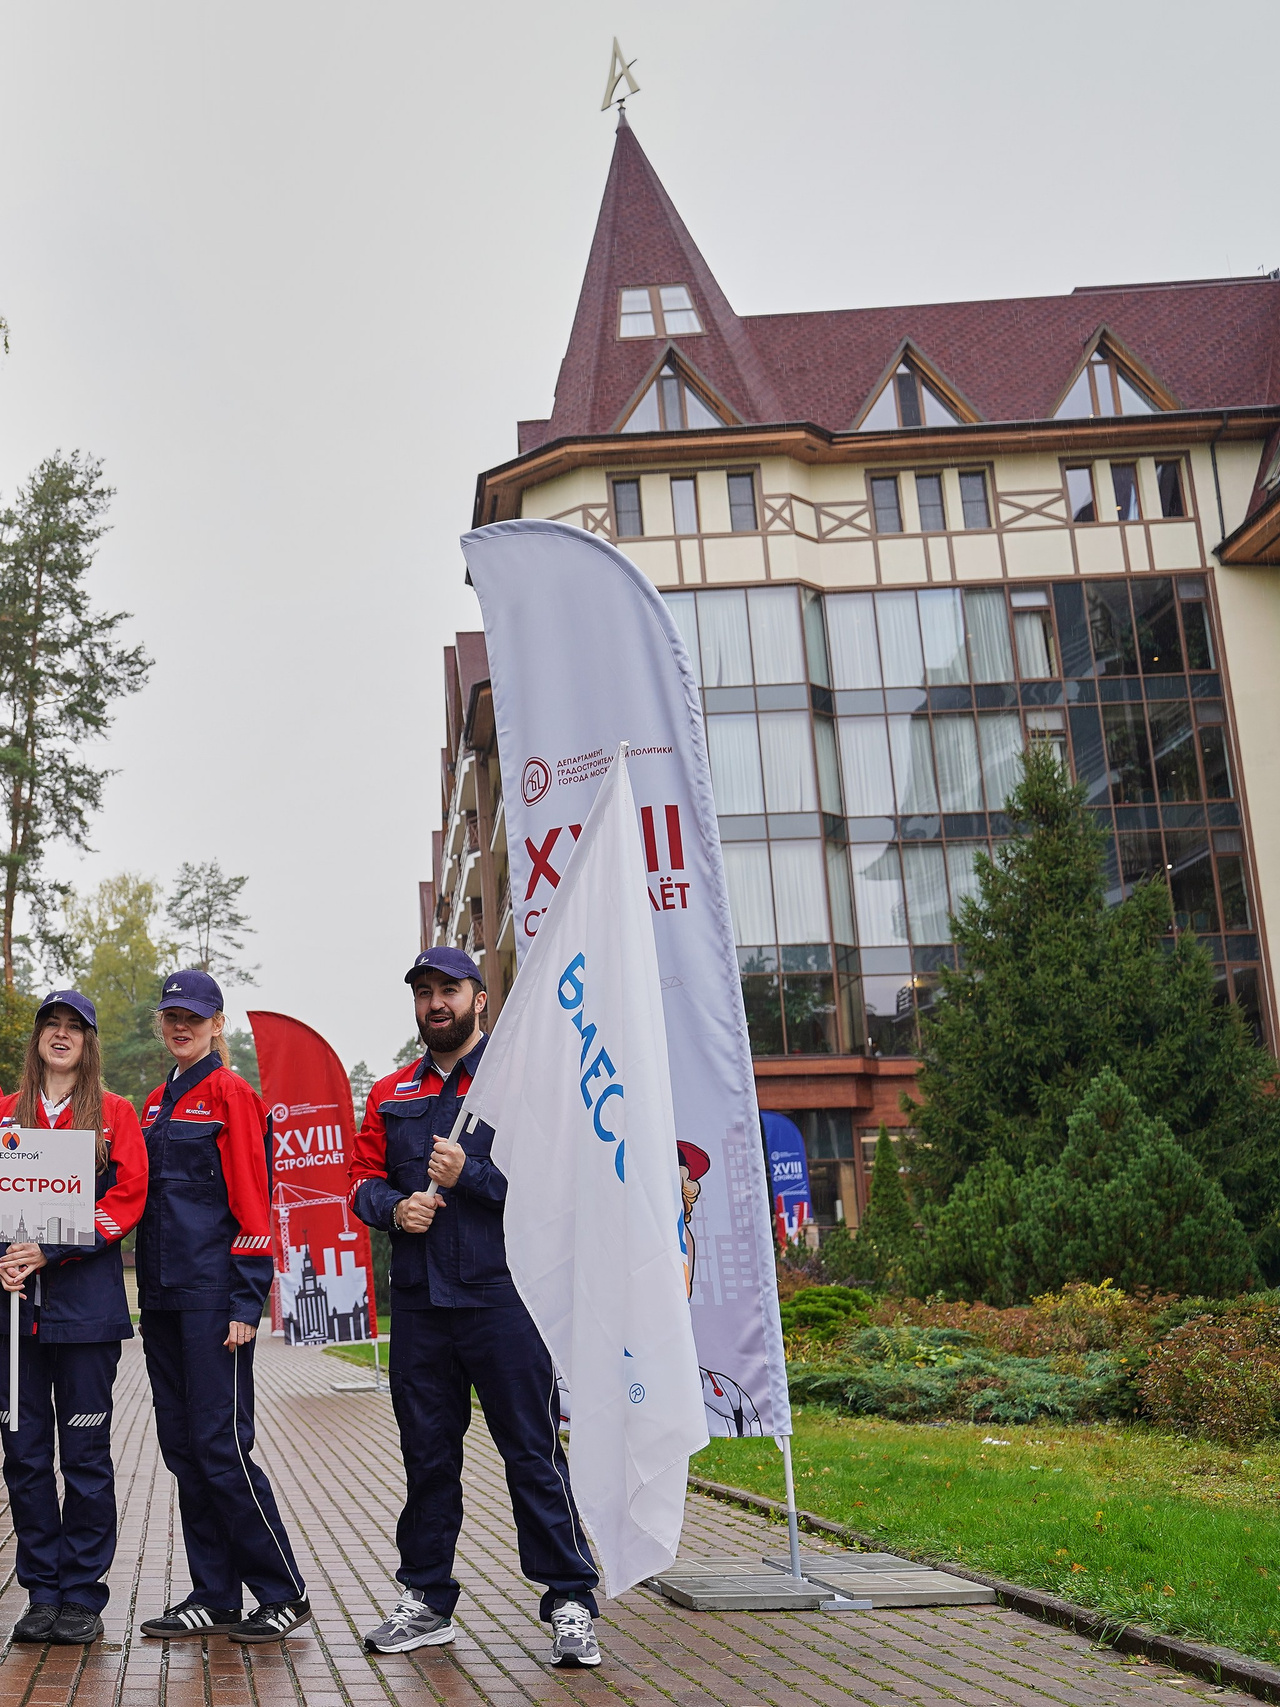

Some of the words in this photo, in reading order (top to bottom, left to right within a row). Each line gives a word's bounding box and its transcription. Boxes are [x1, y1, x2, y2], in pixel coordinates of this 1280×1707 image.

[557, 748, 603, 768] ДЕПАРТАМЕНТ
[631, 746, 673, 757] ПОЛИТИКИ
[558, 773, 589, 786] ГОРОДА
[273, 1124, 343, 1158] XVIII
[274, 1151, 345, 1172] СТРОЙСЛЁТ
[773, 1161, 803, 1176] XVIII
